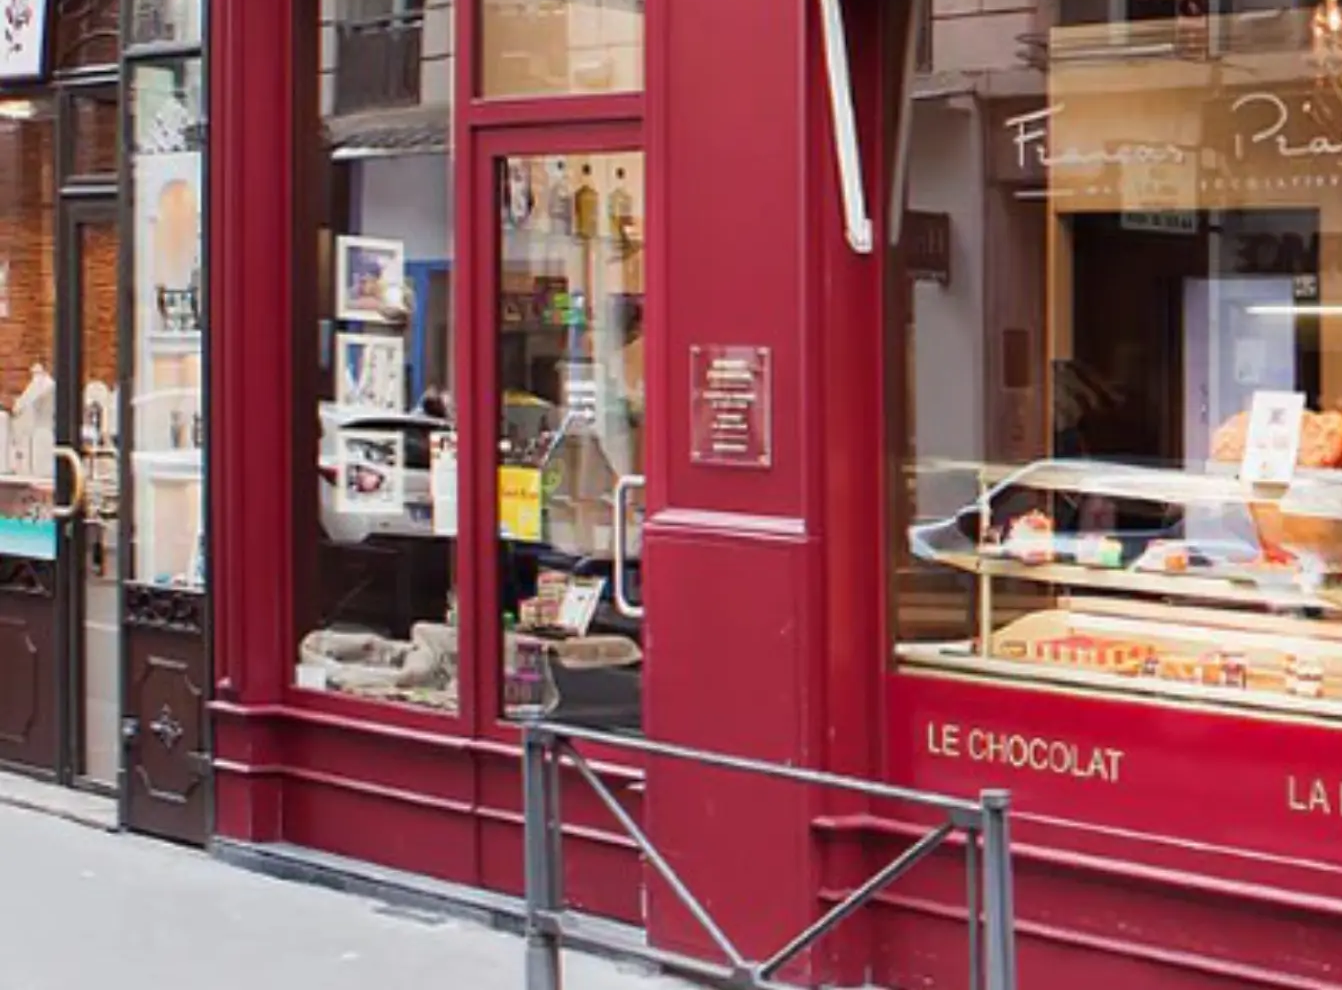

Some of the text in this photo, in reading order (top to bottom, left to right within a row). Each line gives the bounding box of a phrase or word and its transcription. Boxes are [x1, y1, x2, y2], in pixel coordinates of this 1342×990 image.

[927, 720, 1125, 783] LE CHOCOLAT
[1287, 774, 1331, 815] LA
